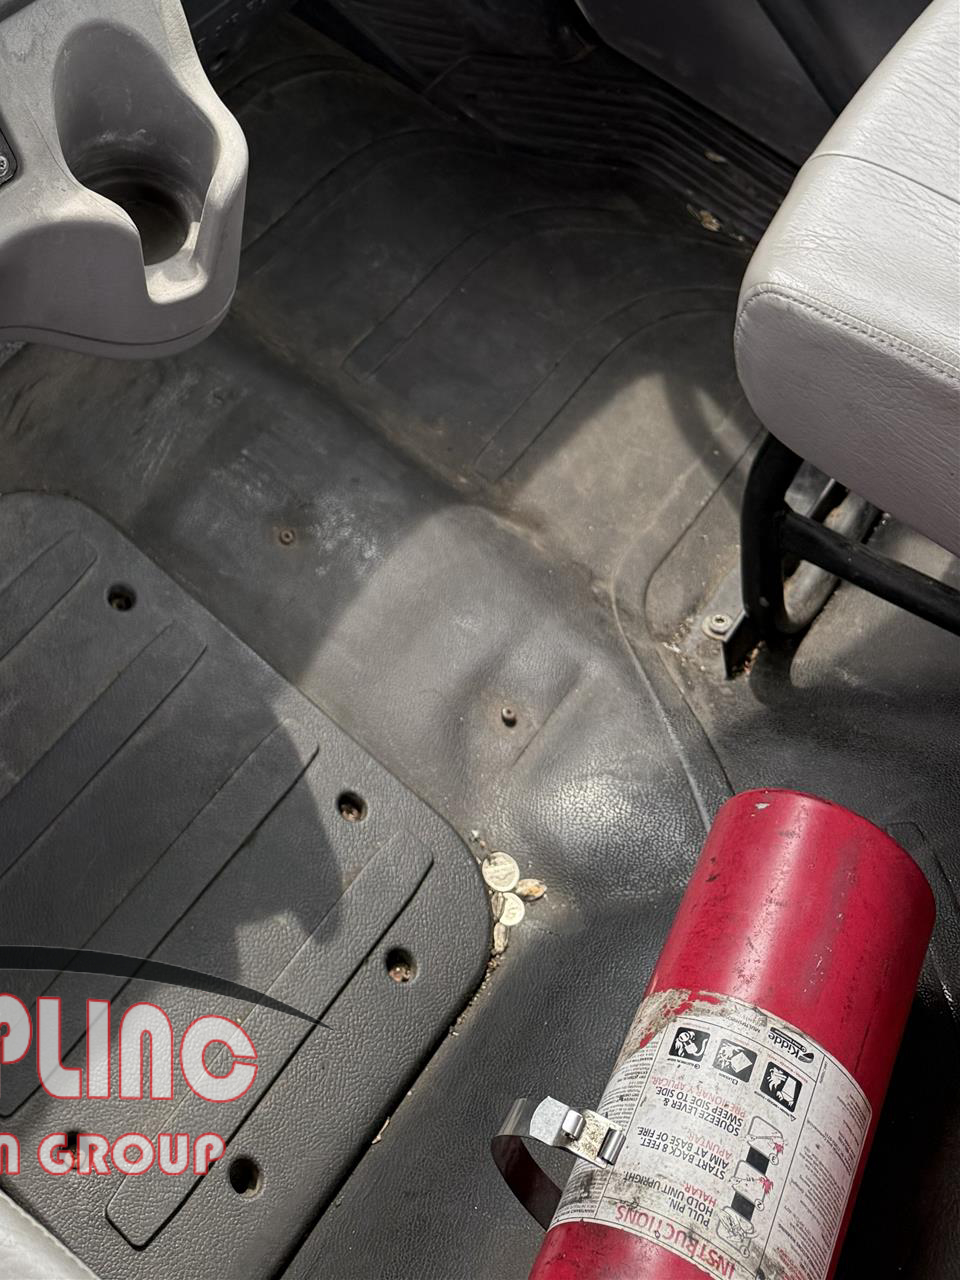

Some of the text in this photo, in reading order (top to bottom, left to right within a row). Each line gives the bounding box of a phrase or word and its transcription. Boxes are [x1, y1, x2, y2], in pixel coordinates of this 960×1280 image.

[767, 1032, 801, 1061] Kidde
[655, 1086, 743, 1127] SWEEP SIDE TO SIDE.
[663, 1098, 740, 1137] SQUEEZE LEVER &
[637, 1126, 730, 1169] AIM AT BASE OF FIRE.
[640, 1137, 726, 1180] START BACK 8 FEET.
[622, 1171, 714, 1217] HOLD UNIT UPRIGHT.
[668, 1197, 711, 1228] PULL PIN.
[615, 1204, 736, 1280] INSTRUCTIONS
